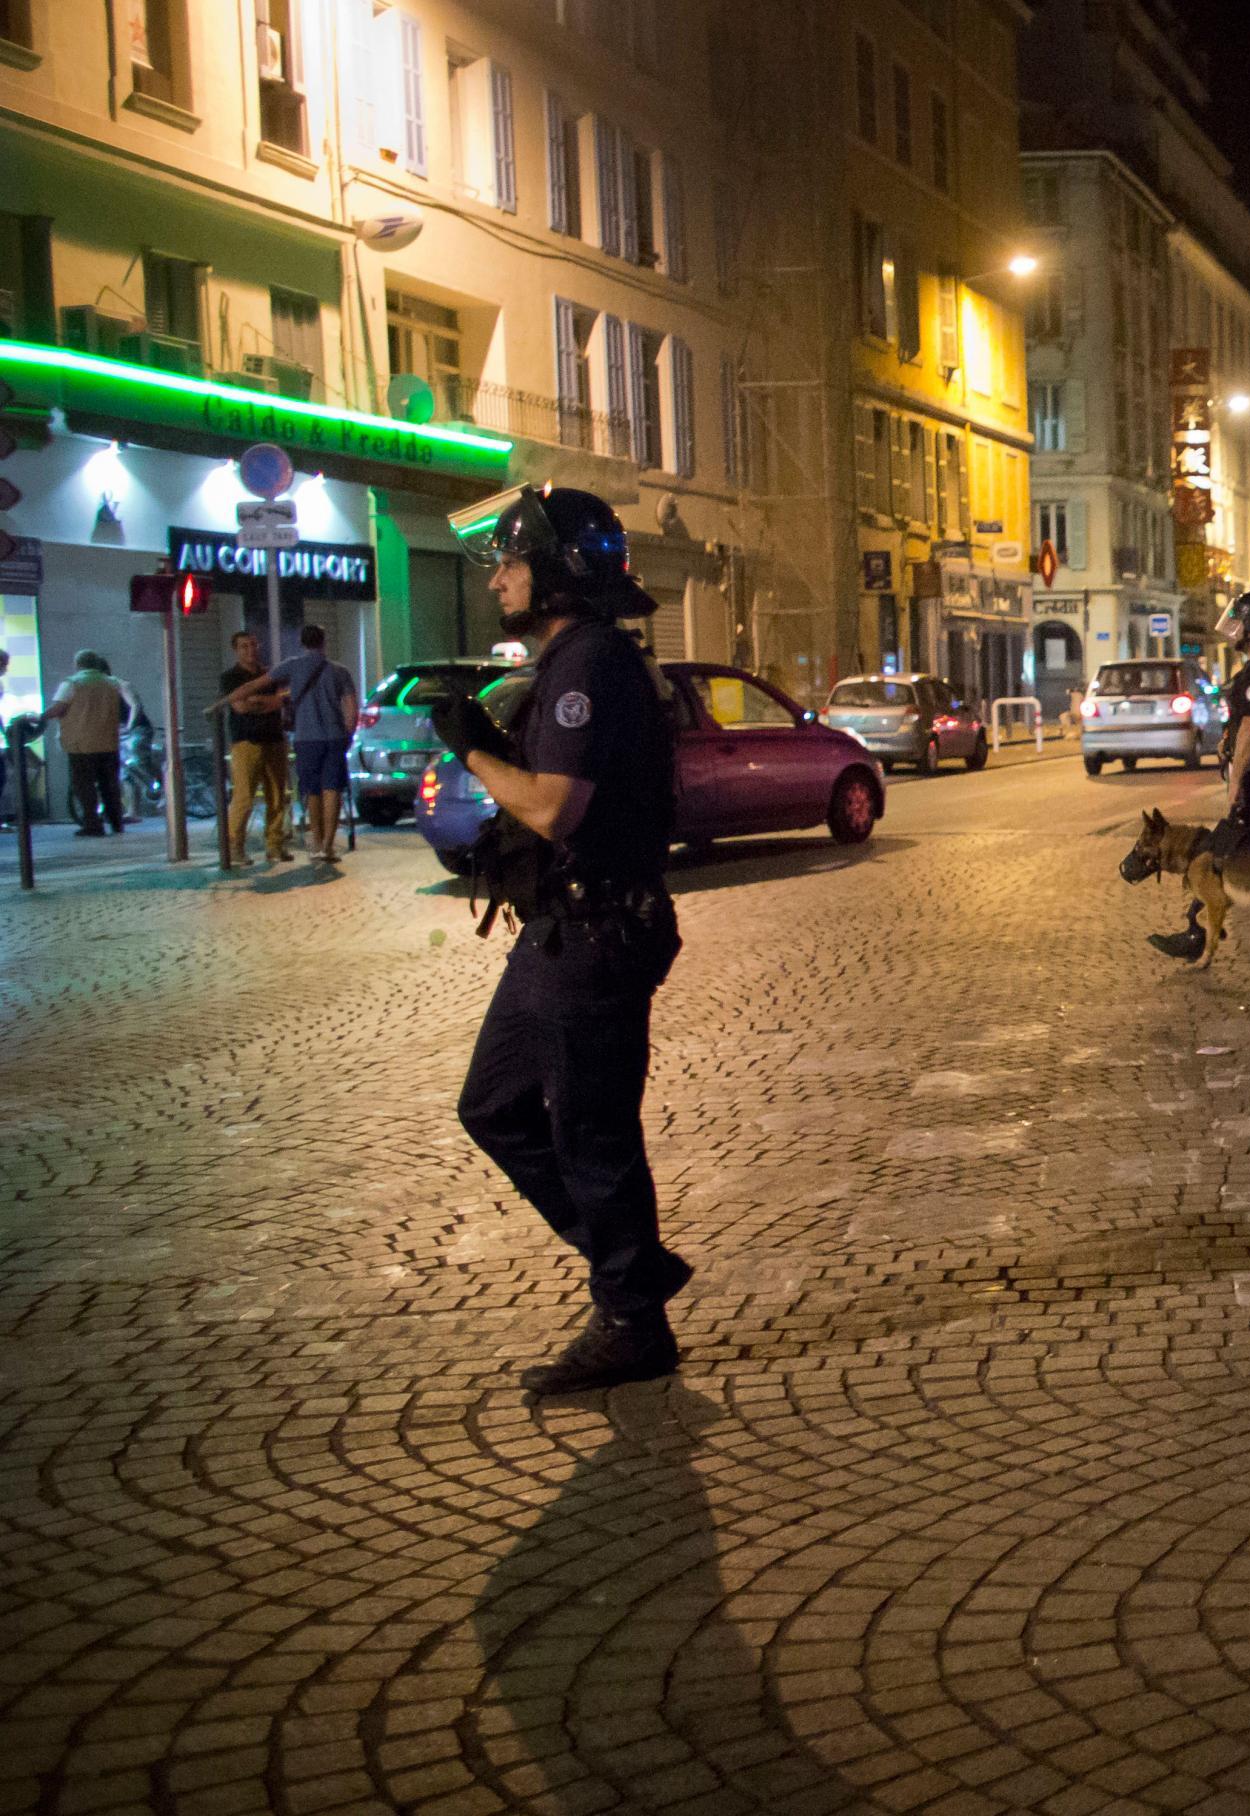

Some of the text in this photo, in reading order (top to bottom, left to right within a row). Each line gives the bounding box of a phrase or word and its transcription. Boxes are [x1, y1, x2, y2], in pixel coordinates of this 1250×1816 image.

[203, 394, 434, 465] Caldo & Freddo
[178, 543, 213, 571] AU
[279, 551, 310, 580] DU
[313, 554, 369, 584] PORT
